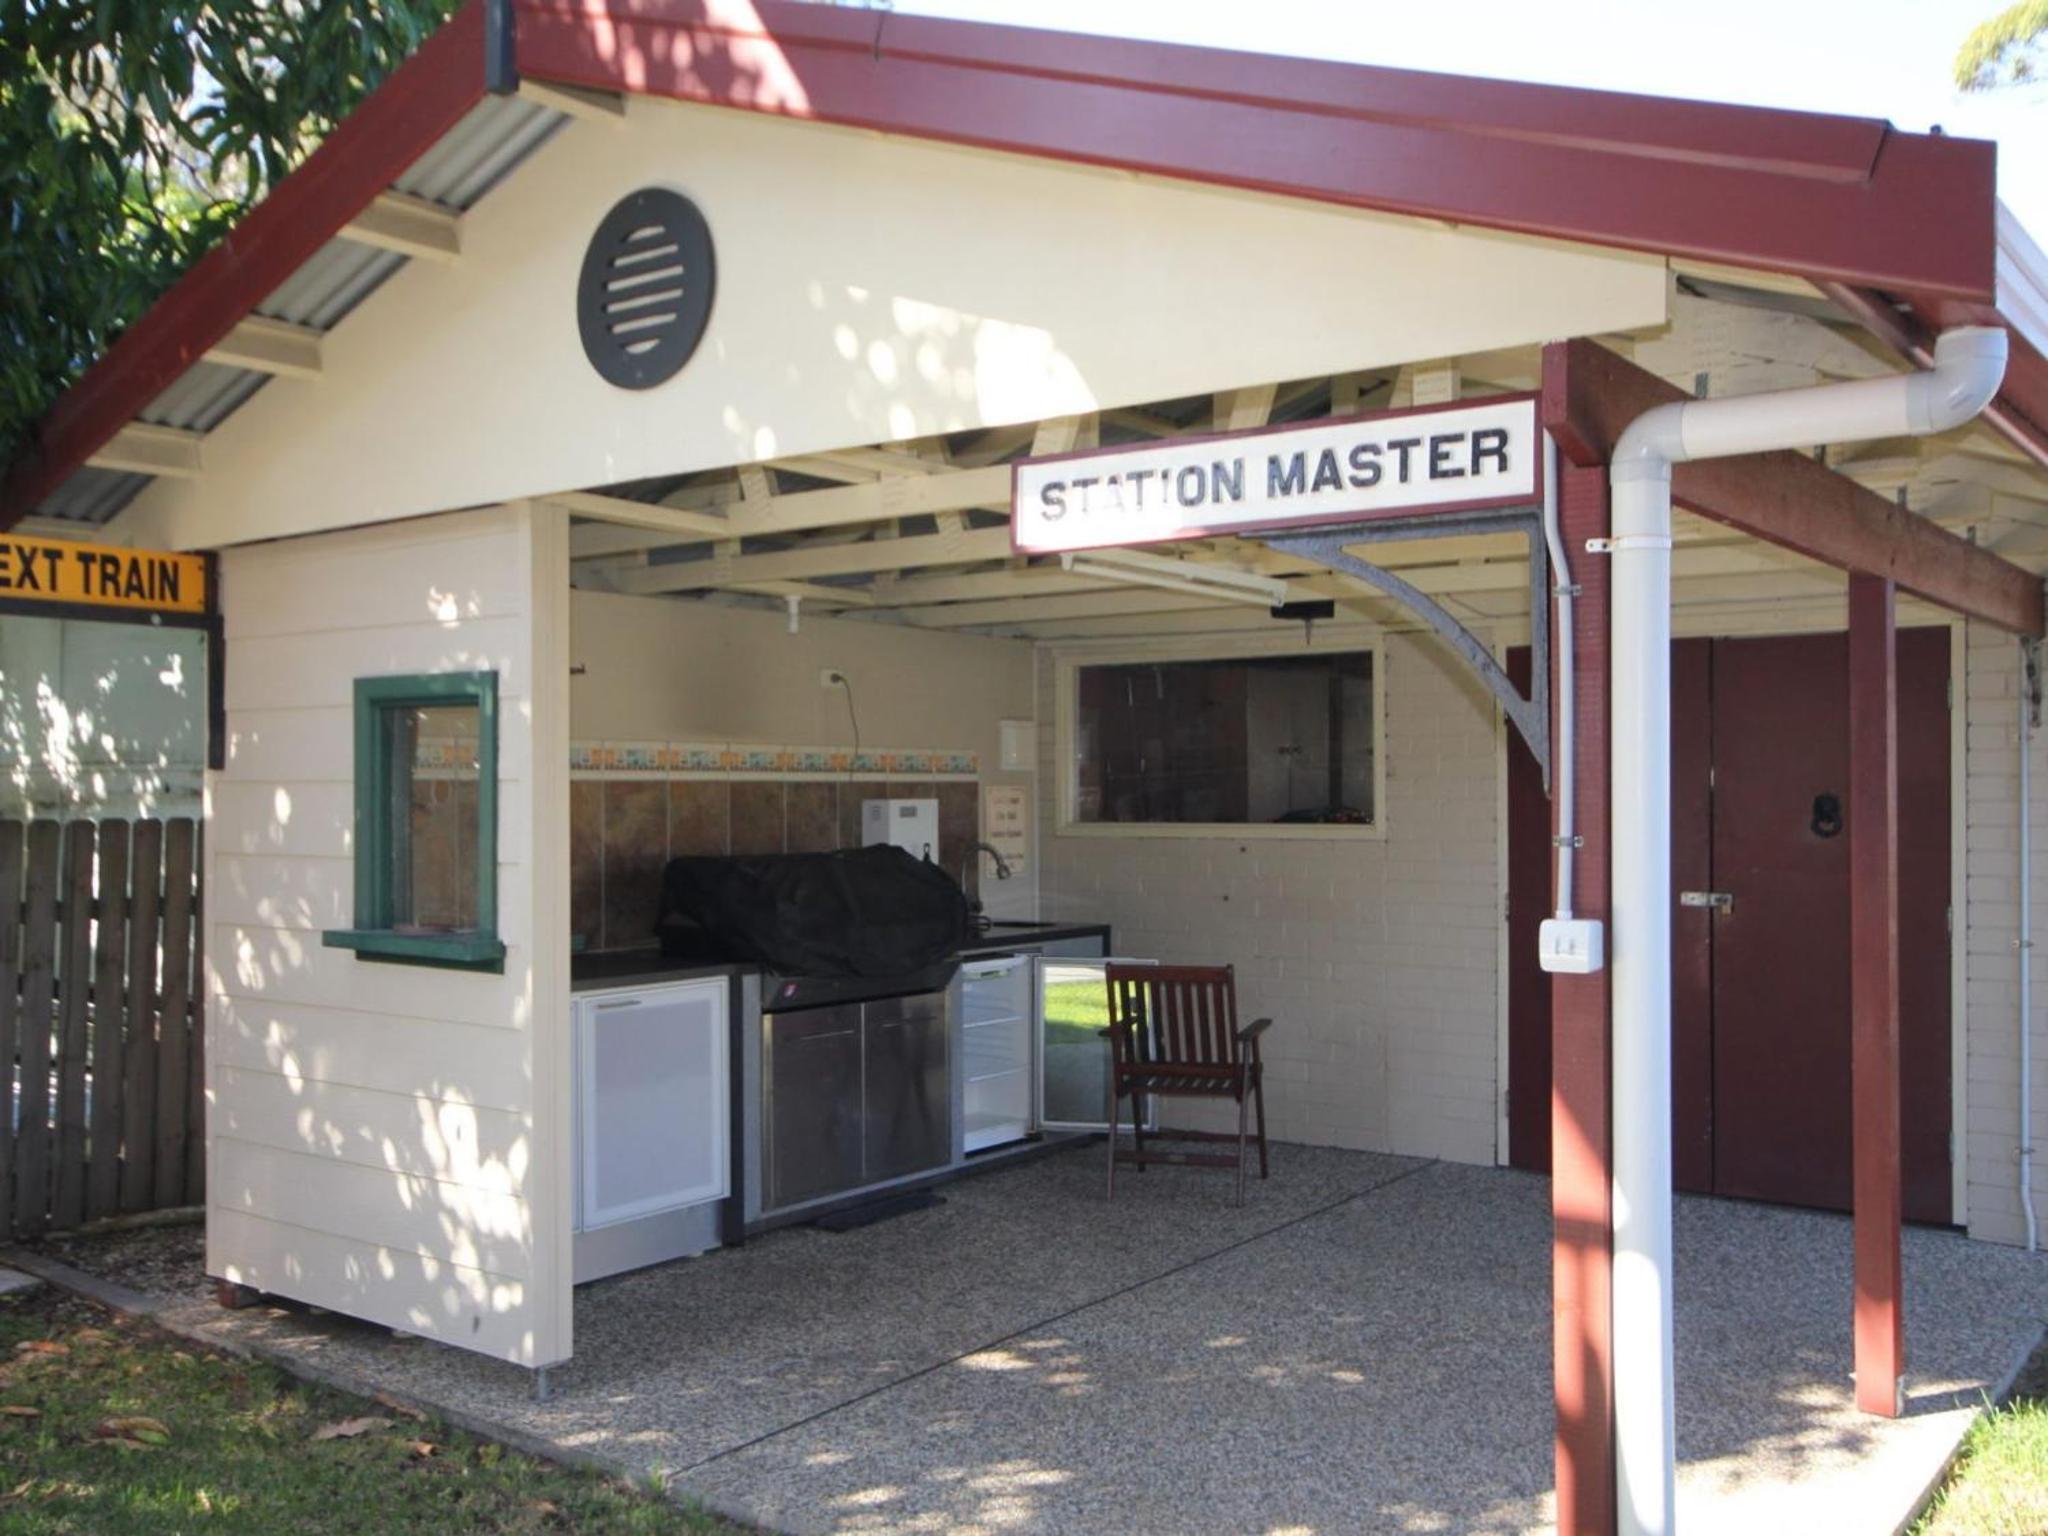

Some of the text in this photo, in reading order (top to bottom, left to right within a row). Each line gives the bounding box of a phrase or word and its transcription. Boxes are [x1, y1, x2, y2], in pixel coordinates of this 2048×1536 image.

[1040, 427, 1510, 522] STATION MASTER
[77, 551, 179, 602] TRAIN
